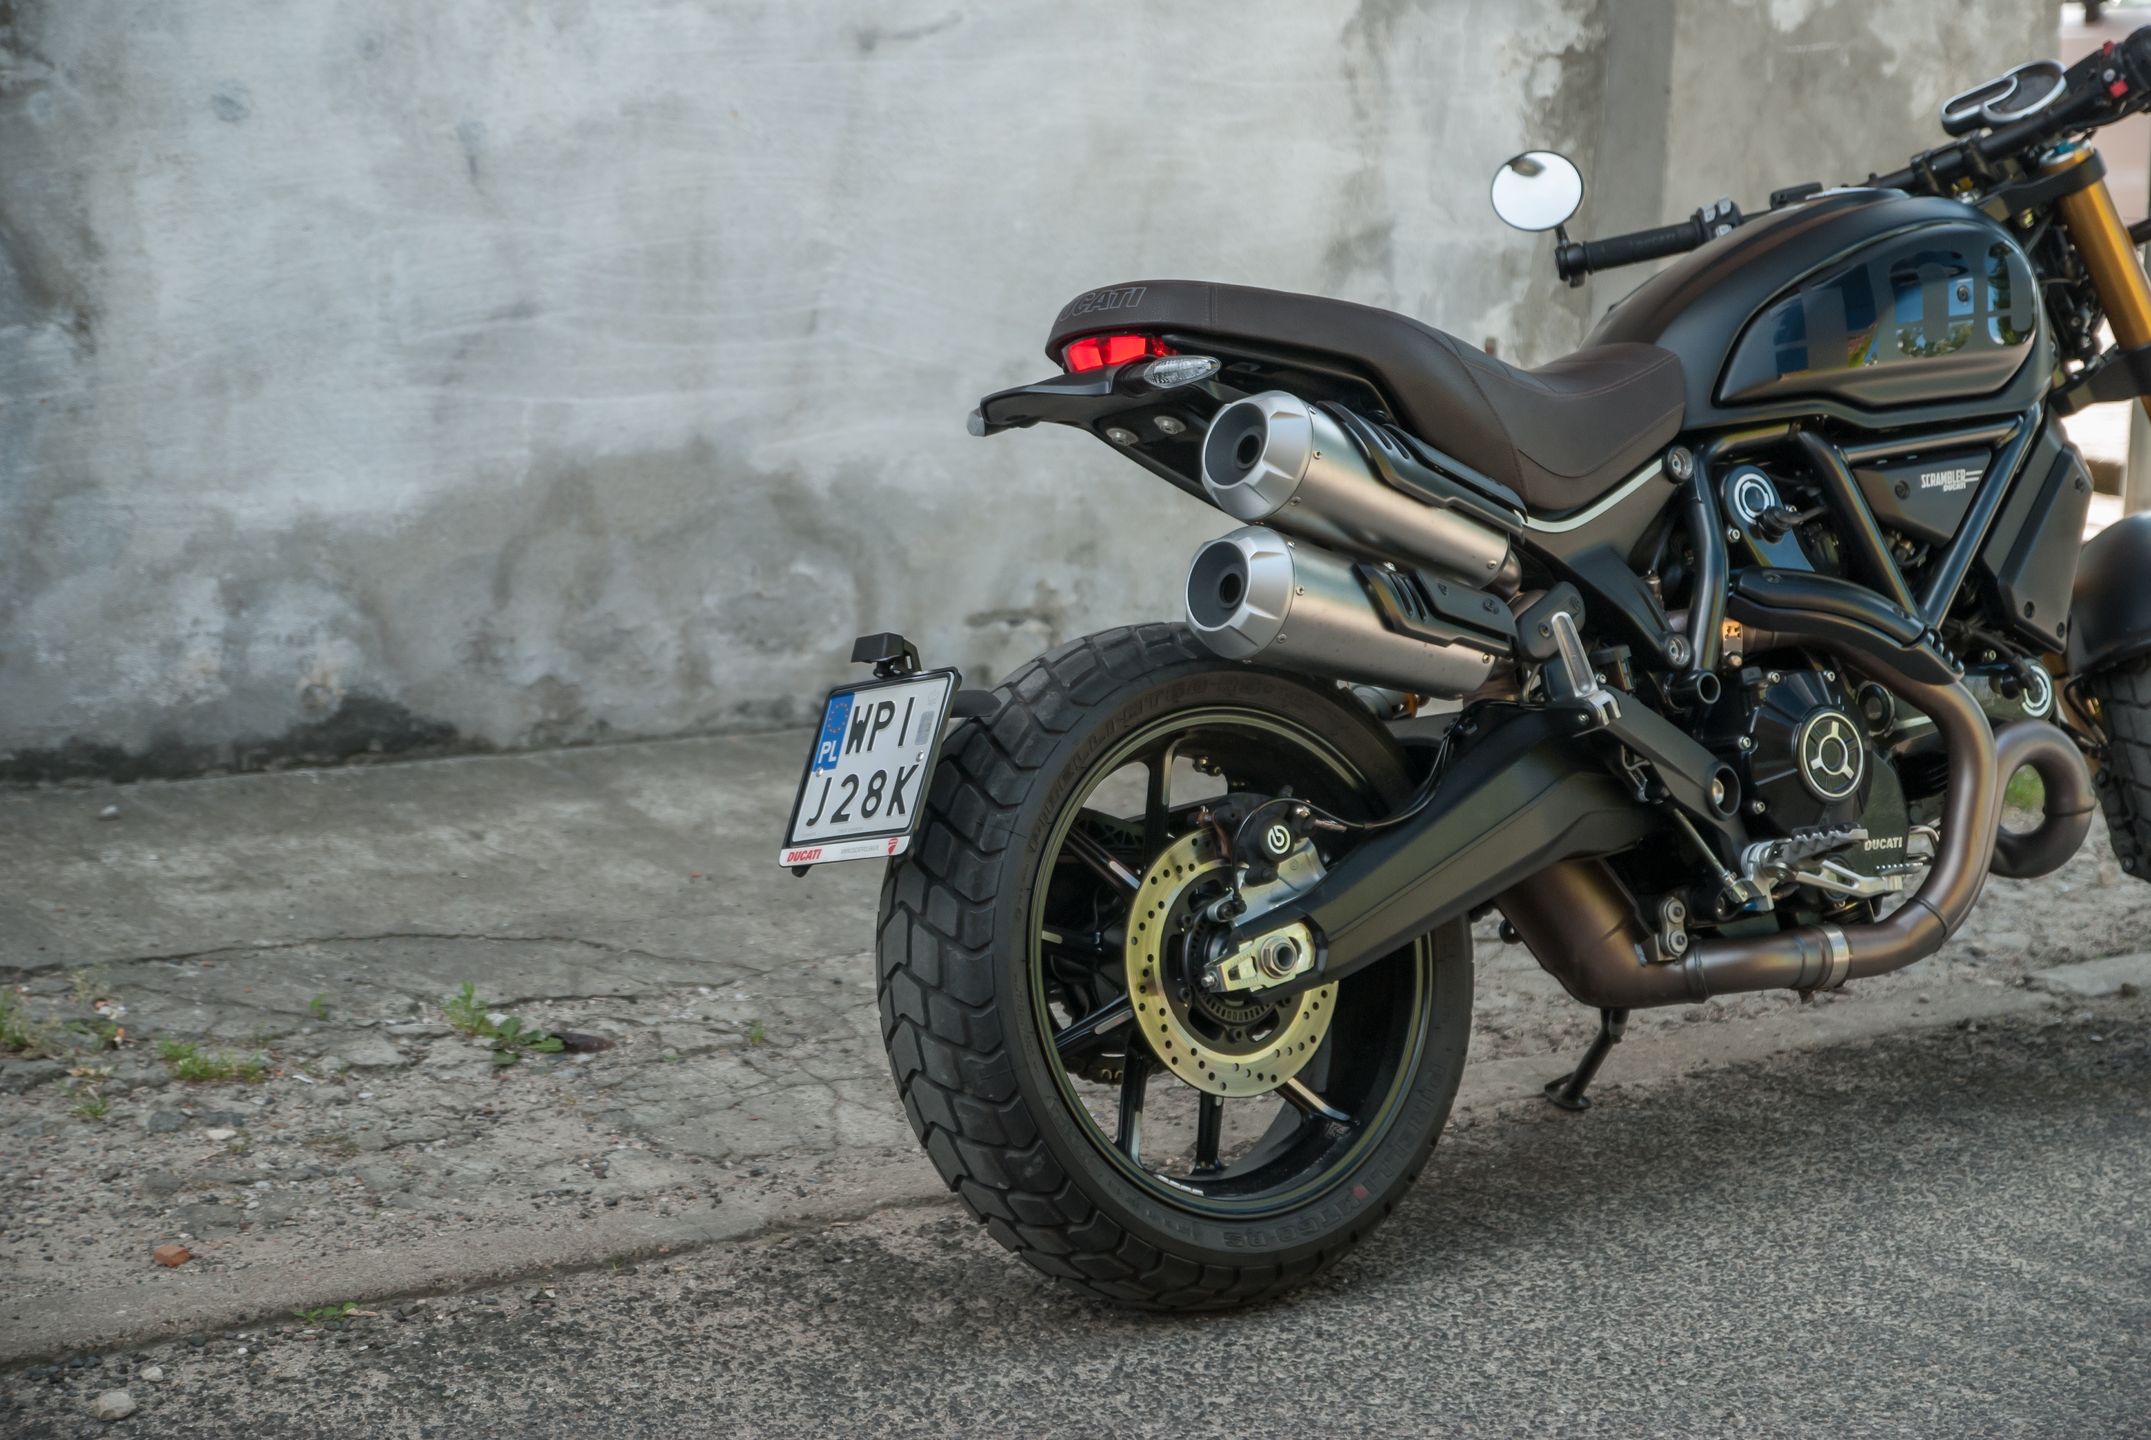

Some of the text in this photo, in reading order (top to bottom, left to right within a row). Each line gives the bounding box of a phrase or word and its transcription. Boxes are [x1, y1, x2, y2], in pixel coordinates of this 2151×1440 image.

[1920, 468, 1966, 489] SCRAMBLER
[845, 696, 916, 755] WPI
[818, 740, 837, 763] PL
[806, 764, 919, 827] J28K
[1864, 836, 1903, 851] DUCATI
[786, 848, 823, 862] DUCATI
